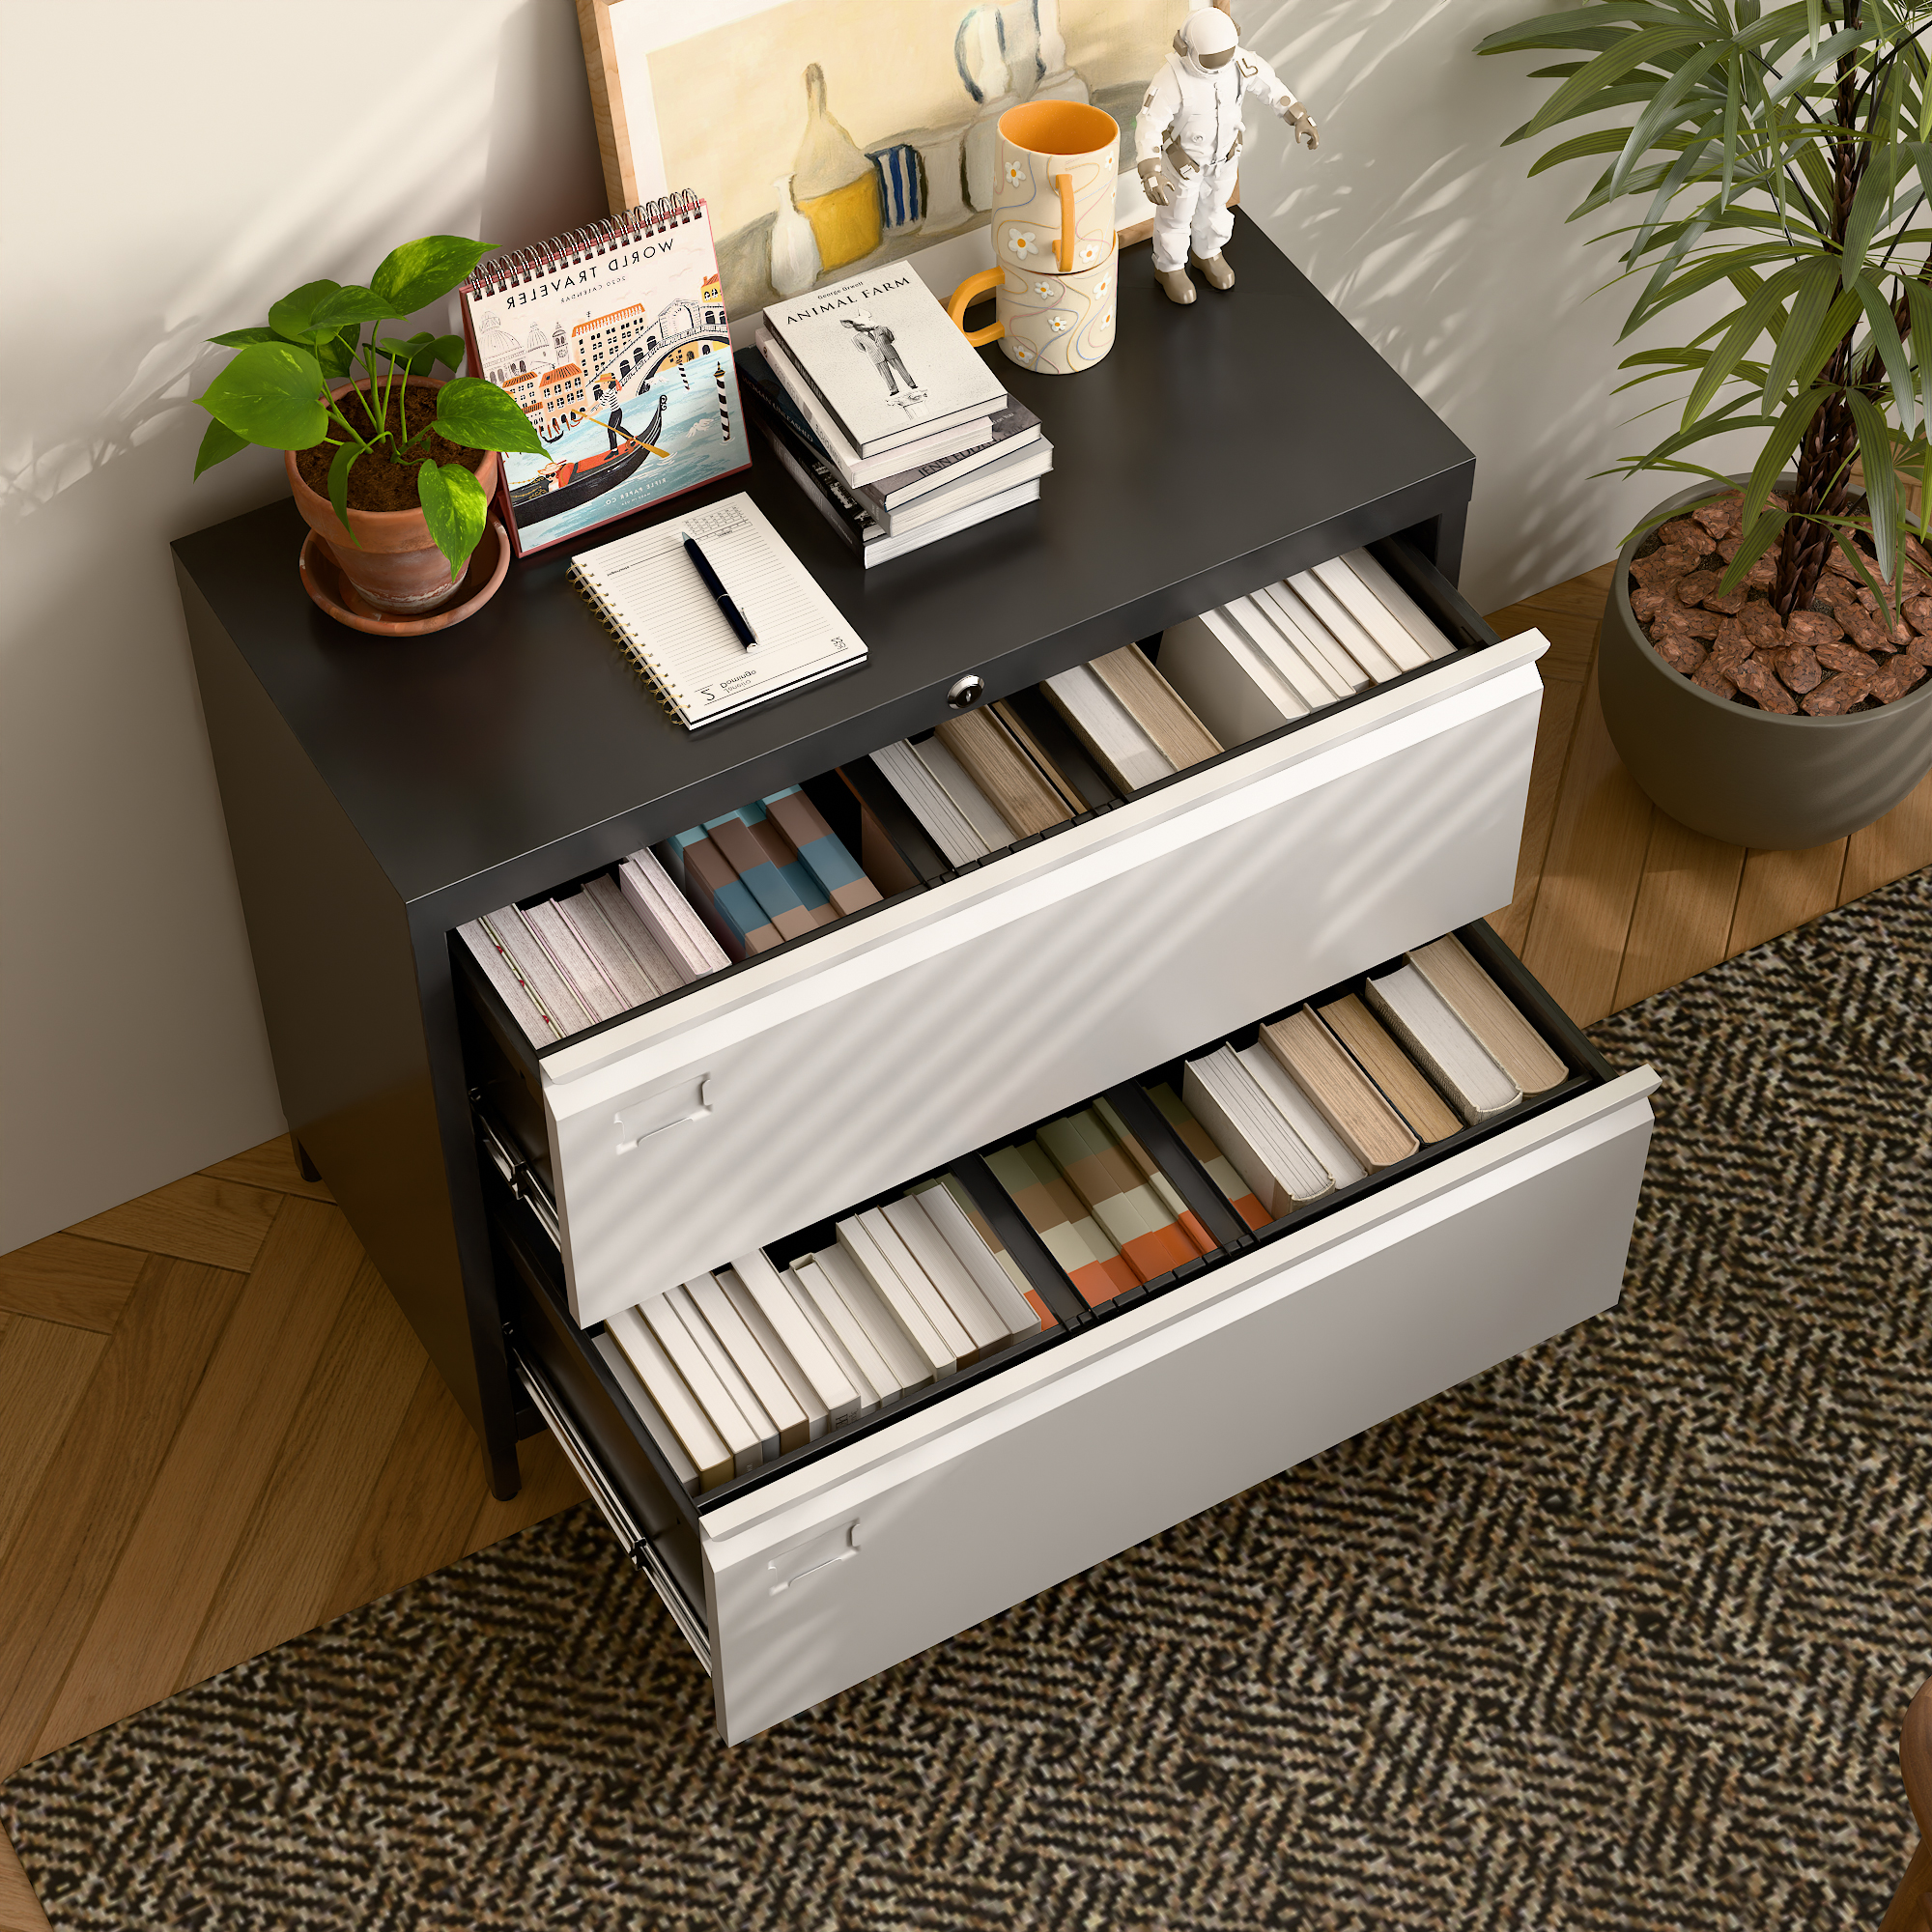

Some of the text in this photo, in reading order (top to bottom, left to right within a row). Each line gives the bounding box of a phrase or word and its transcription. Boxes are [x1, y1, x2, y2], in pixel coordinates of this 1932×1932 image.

[787, 277, 910, 325] ANIMAL FARM
[817, 281, 864, 300] George Orwell
